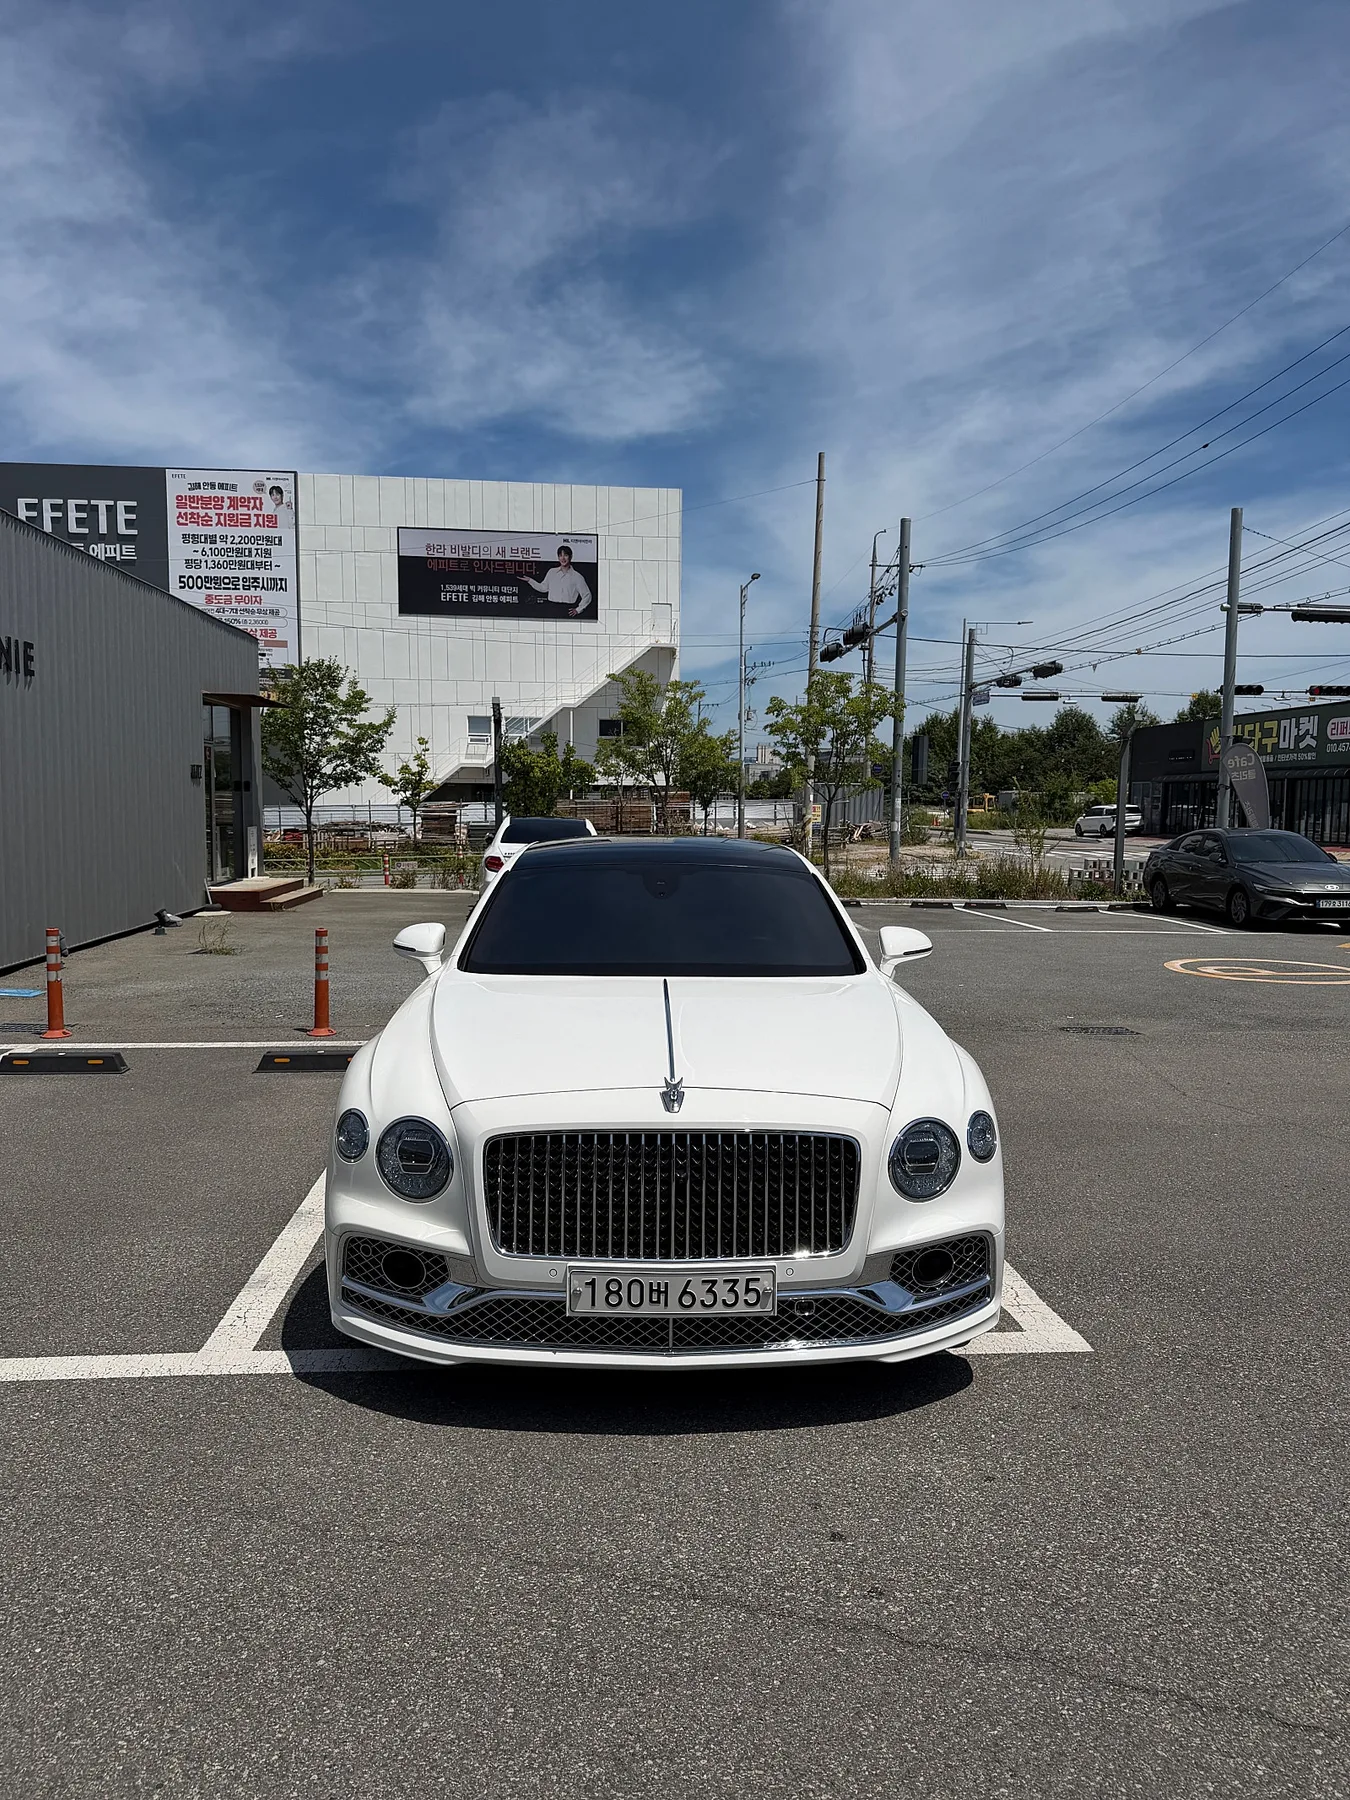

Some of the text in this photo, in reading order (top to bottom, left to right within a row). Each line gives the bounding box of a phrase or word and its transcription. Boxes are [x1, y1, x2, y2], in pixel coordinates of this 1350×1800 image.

[187, 481, 239, 492] 김해 안동 에피트
[175, 494, 264, 512] 일반분양 계약자
[176, 511, 279, 529] 선착순 지원금 지원
[181, 533, 283, 547] 평형대별 약 2,200만원대
[89, 543, 137, 561] 에피트
[201, 547, 253, 558] 6,100만원대
[254, 548, 272, 559] 지원
[425, 543, 542, 559] 한라 비발디의 새 브랜드
[184, 558, 202, 570] 평당
[204, 560, 273, 571] 1,360만원대부터
[427, 558, 539, 575] 에피트로 인사드립니다.
[178, 575, 288, 592] 500만원으로 입주시까지
[501, 586, 519, 594] 대단지
[204, 593, 263, 606] 중도금 무이자
[440, 592, 469, 602] EFETE
[471, 594, 485, 603] 김해
[485, 595, 499, 604] 안동
[499, 595, 519, 604] 에피트
[259, 628, 278, 639] 제공
[1330, 721, 1350, 736] 리퍼
[1326, 742, 1350, 753] 010.457
[677, 1277, 761, 1309] 6335
